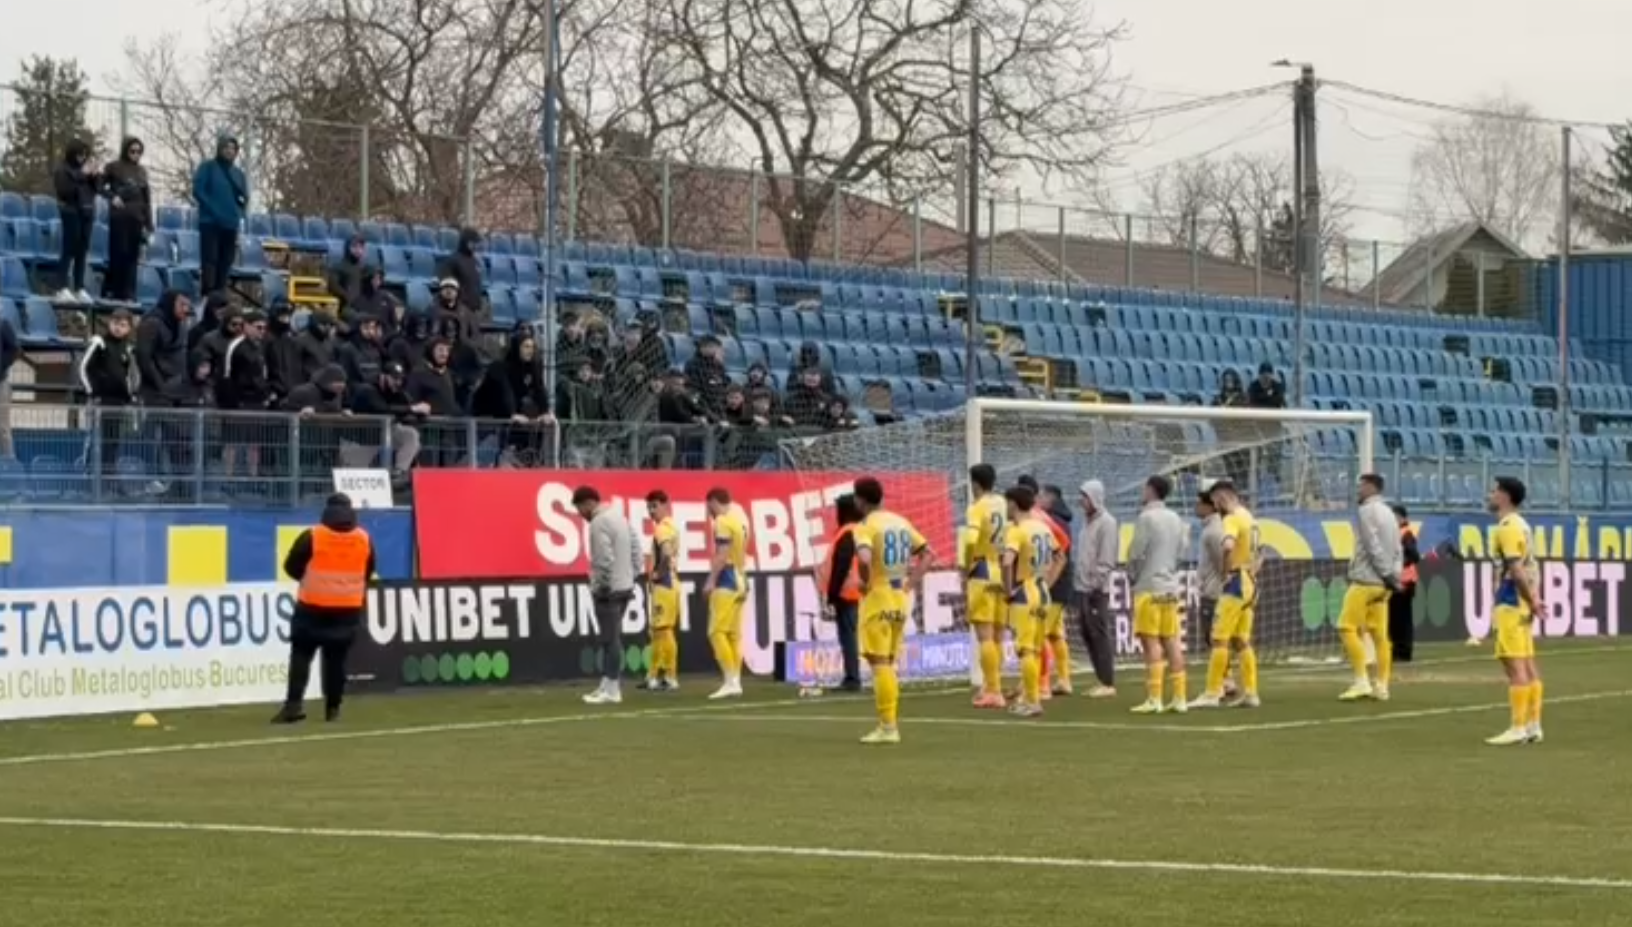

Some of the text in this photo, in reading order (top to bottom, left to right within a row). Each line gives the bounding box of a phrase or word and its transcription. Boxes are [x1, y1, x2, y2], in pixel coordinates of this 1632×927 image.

[341, 477, 386, 491] SECTOR
[884, 529, 911, 566] 88
[367, 584, 536, 645] UNIBET
[18, 668, 66, 699] Club
[72, 662, 206, 699] Metaloglobus
[209, 659, 289, 688] Bucures
